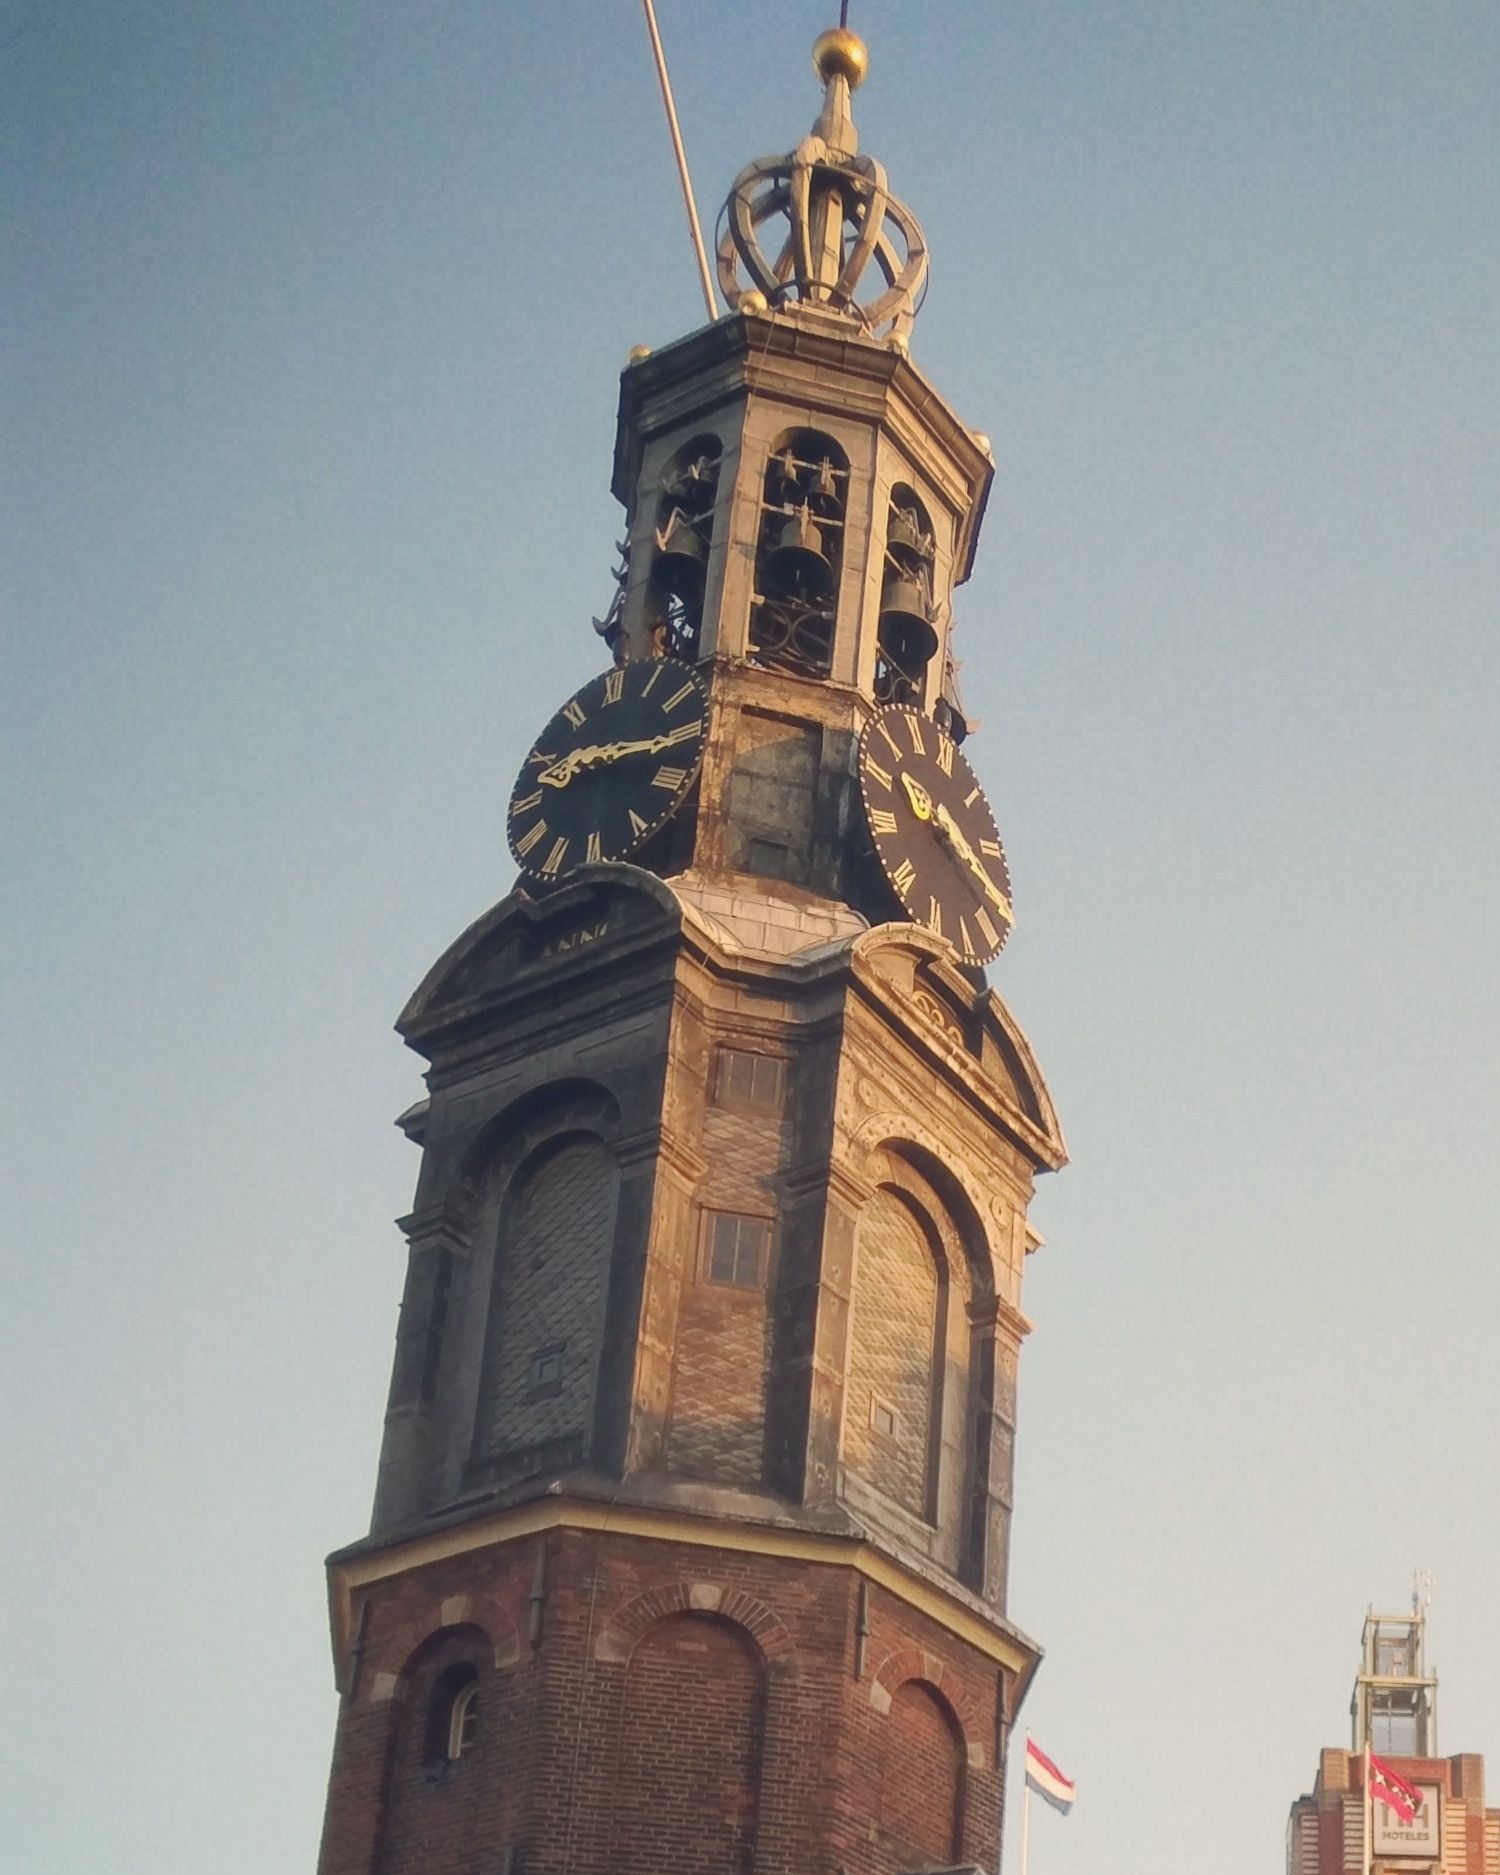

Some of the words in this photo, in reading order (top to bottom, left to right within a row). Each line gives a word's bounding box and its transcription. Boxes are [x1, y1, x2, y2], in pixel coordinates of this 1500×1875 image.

[601, 670, 625, 708] XII
[562, 699, 588, 732] XI
[1382, 1831, 1430, 1841] HOTELES
